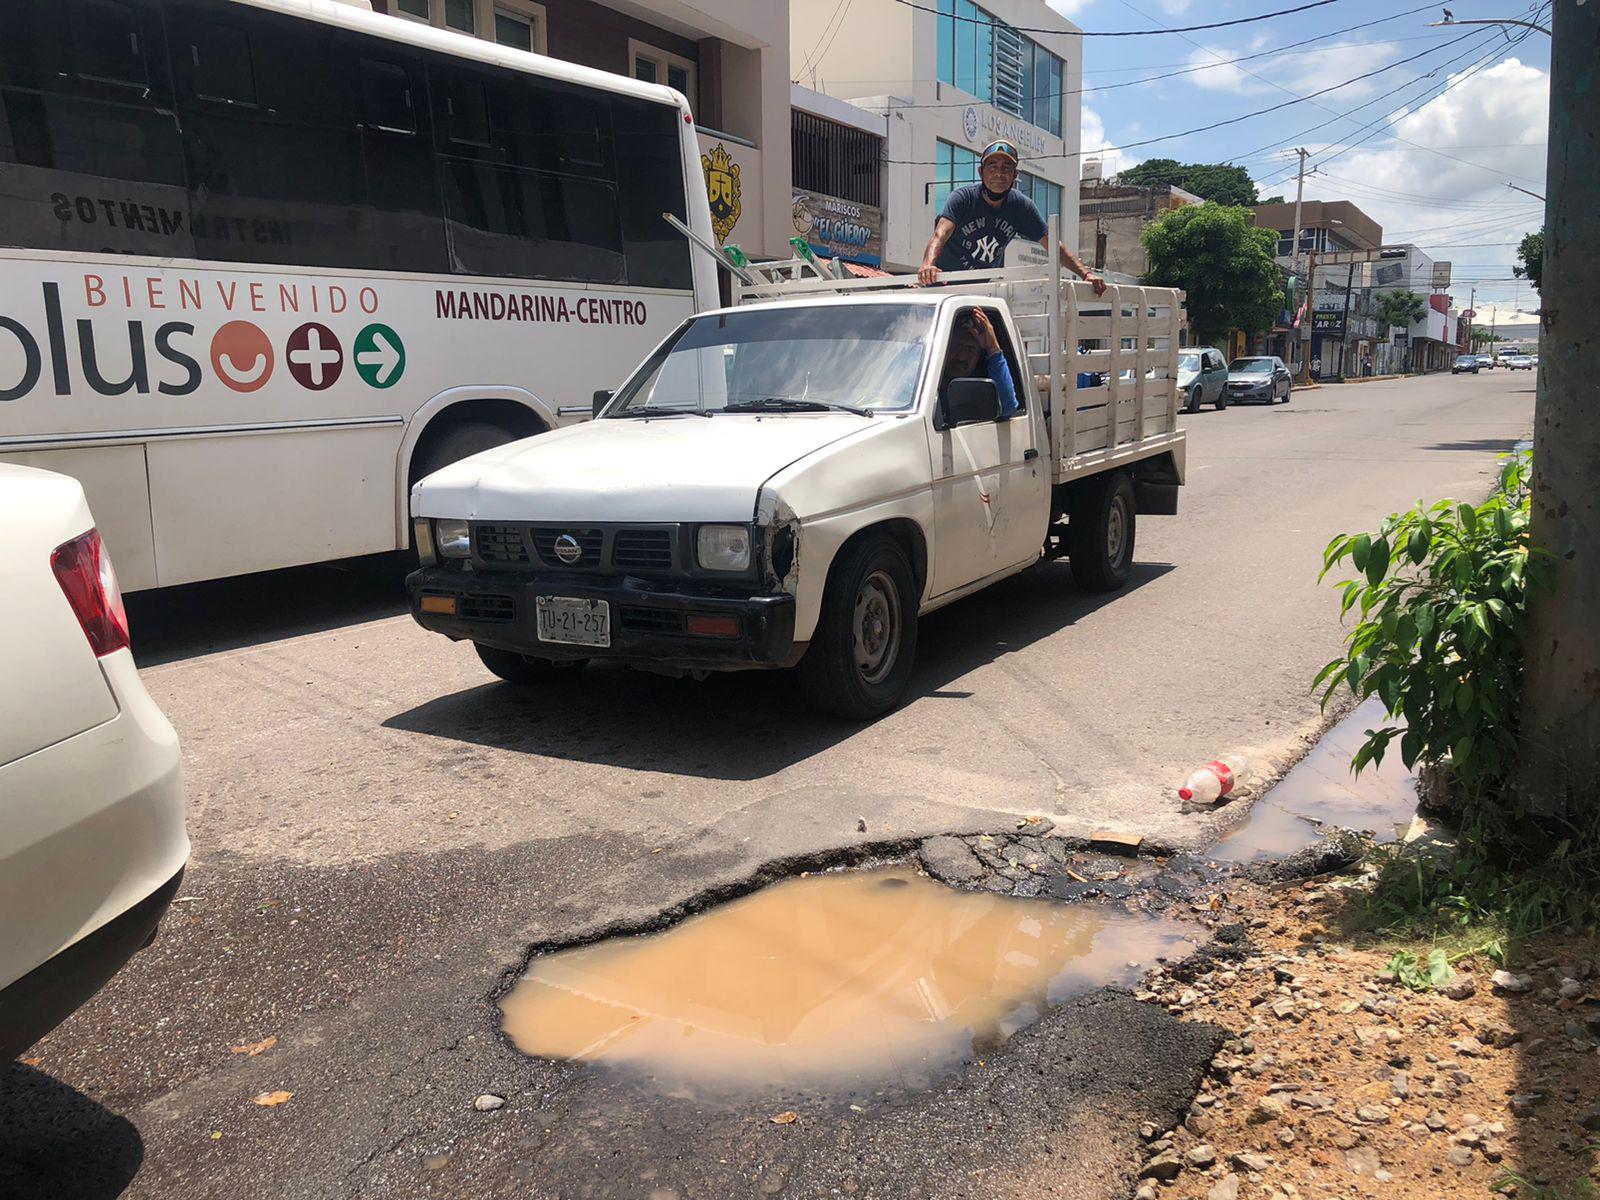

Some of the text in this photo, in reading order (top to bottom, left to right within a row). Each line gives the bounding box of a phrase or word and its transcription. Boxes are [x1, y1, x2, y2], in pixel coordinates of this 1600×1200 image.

[981, 110, 1001, 136] LOS
[825, 200, 861, 218] MARISCOS
[961, 216, 986, 237] NEW
[84, 274, 379, 314] BIENVENIDO
[435, 290, 648, 326] MANDARINA-CENTRO
[540, 608, 607, 633] TU-21-257
